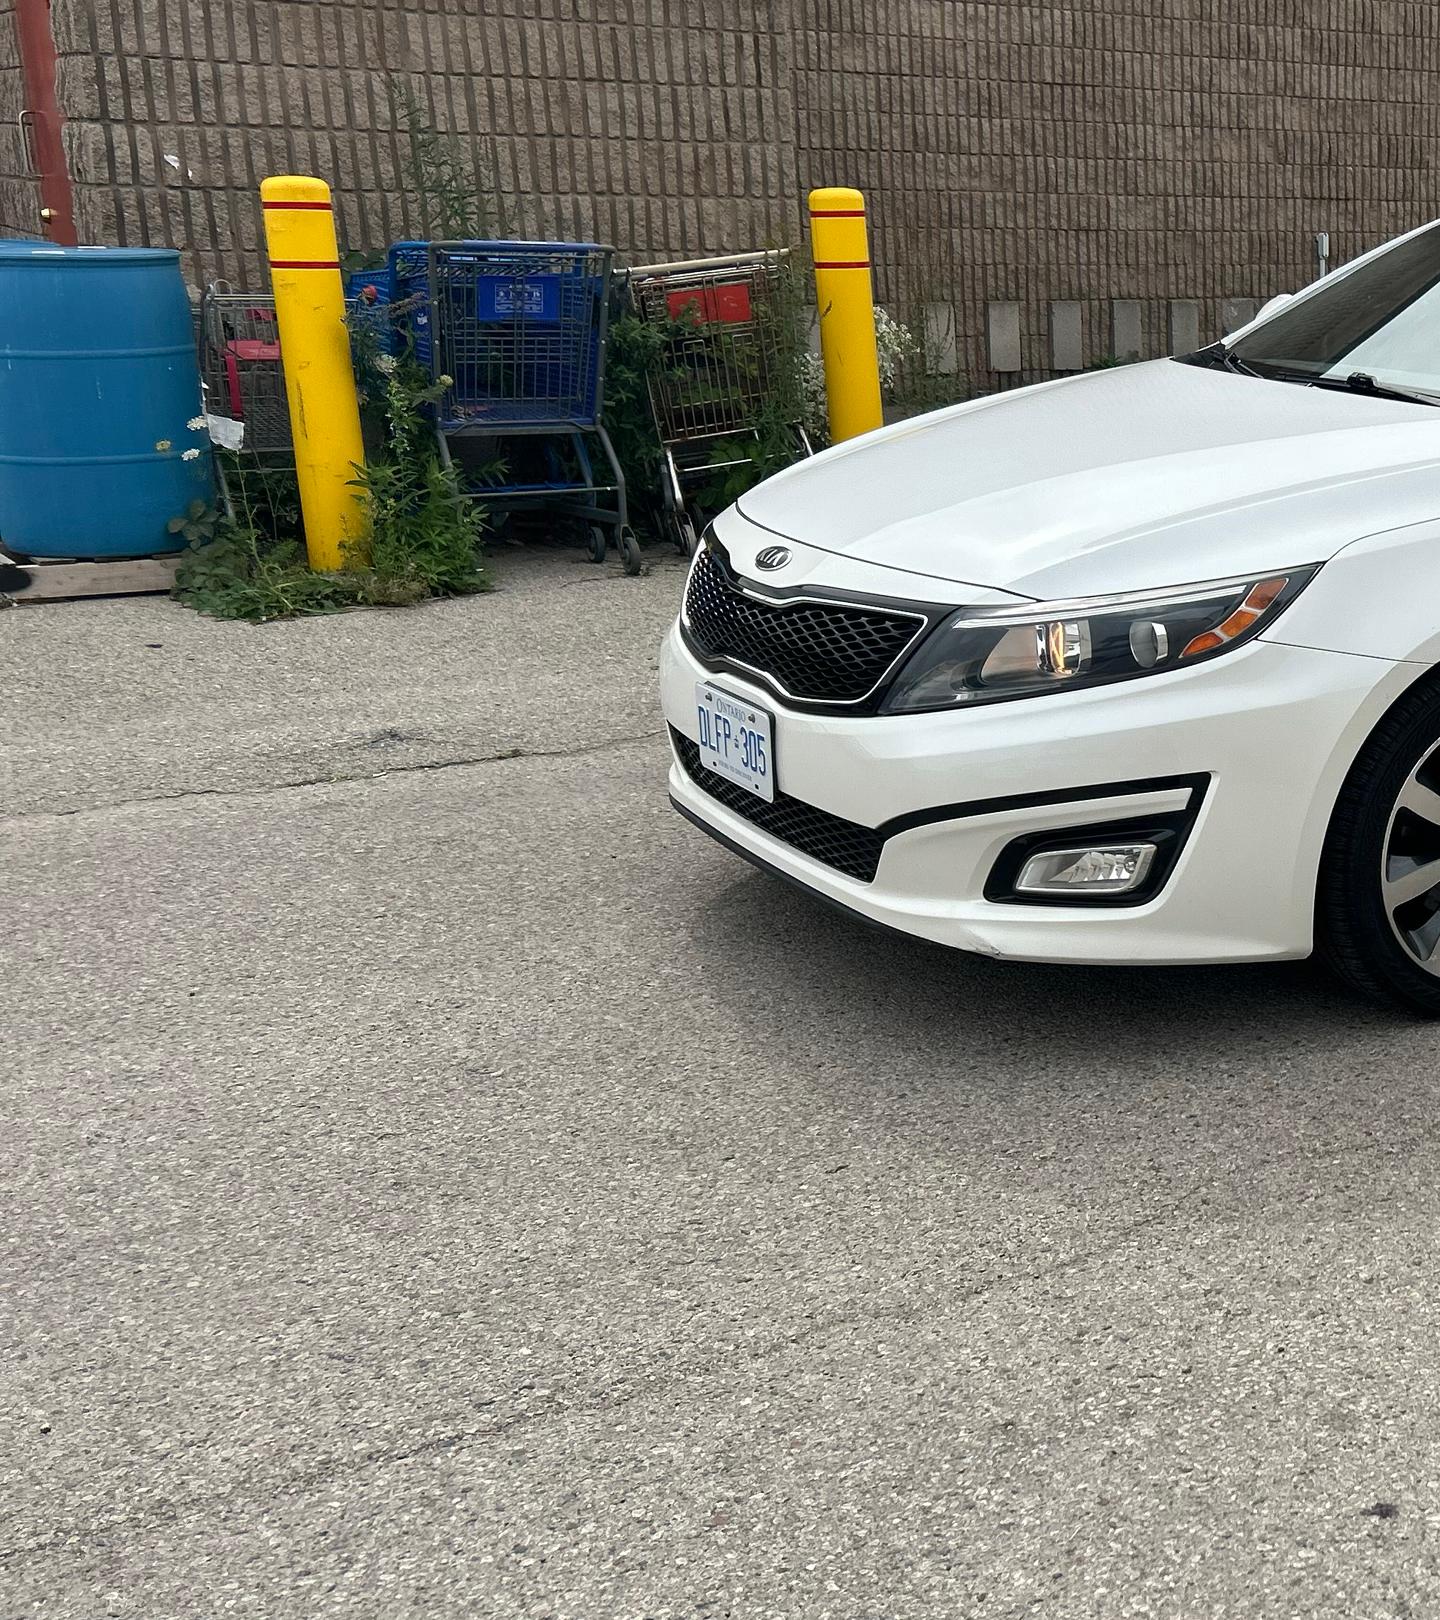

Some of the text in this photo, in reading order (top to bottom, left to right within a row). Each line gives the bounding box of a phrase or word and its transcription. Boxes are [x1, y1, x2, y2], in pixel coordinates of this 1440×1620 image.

[757, 548, 786, 566] KIA
[716, 698, 746, 722] ONTARIO
[698, 705, 731, 758] DLFP
[740, 726, 766, 776] 305
